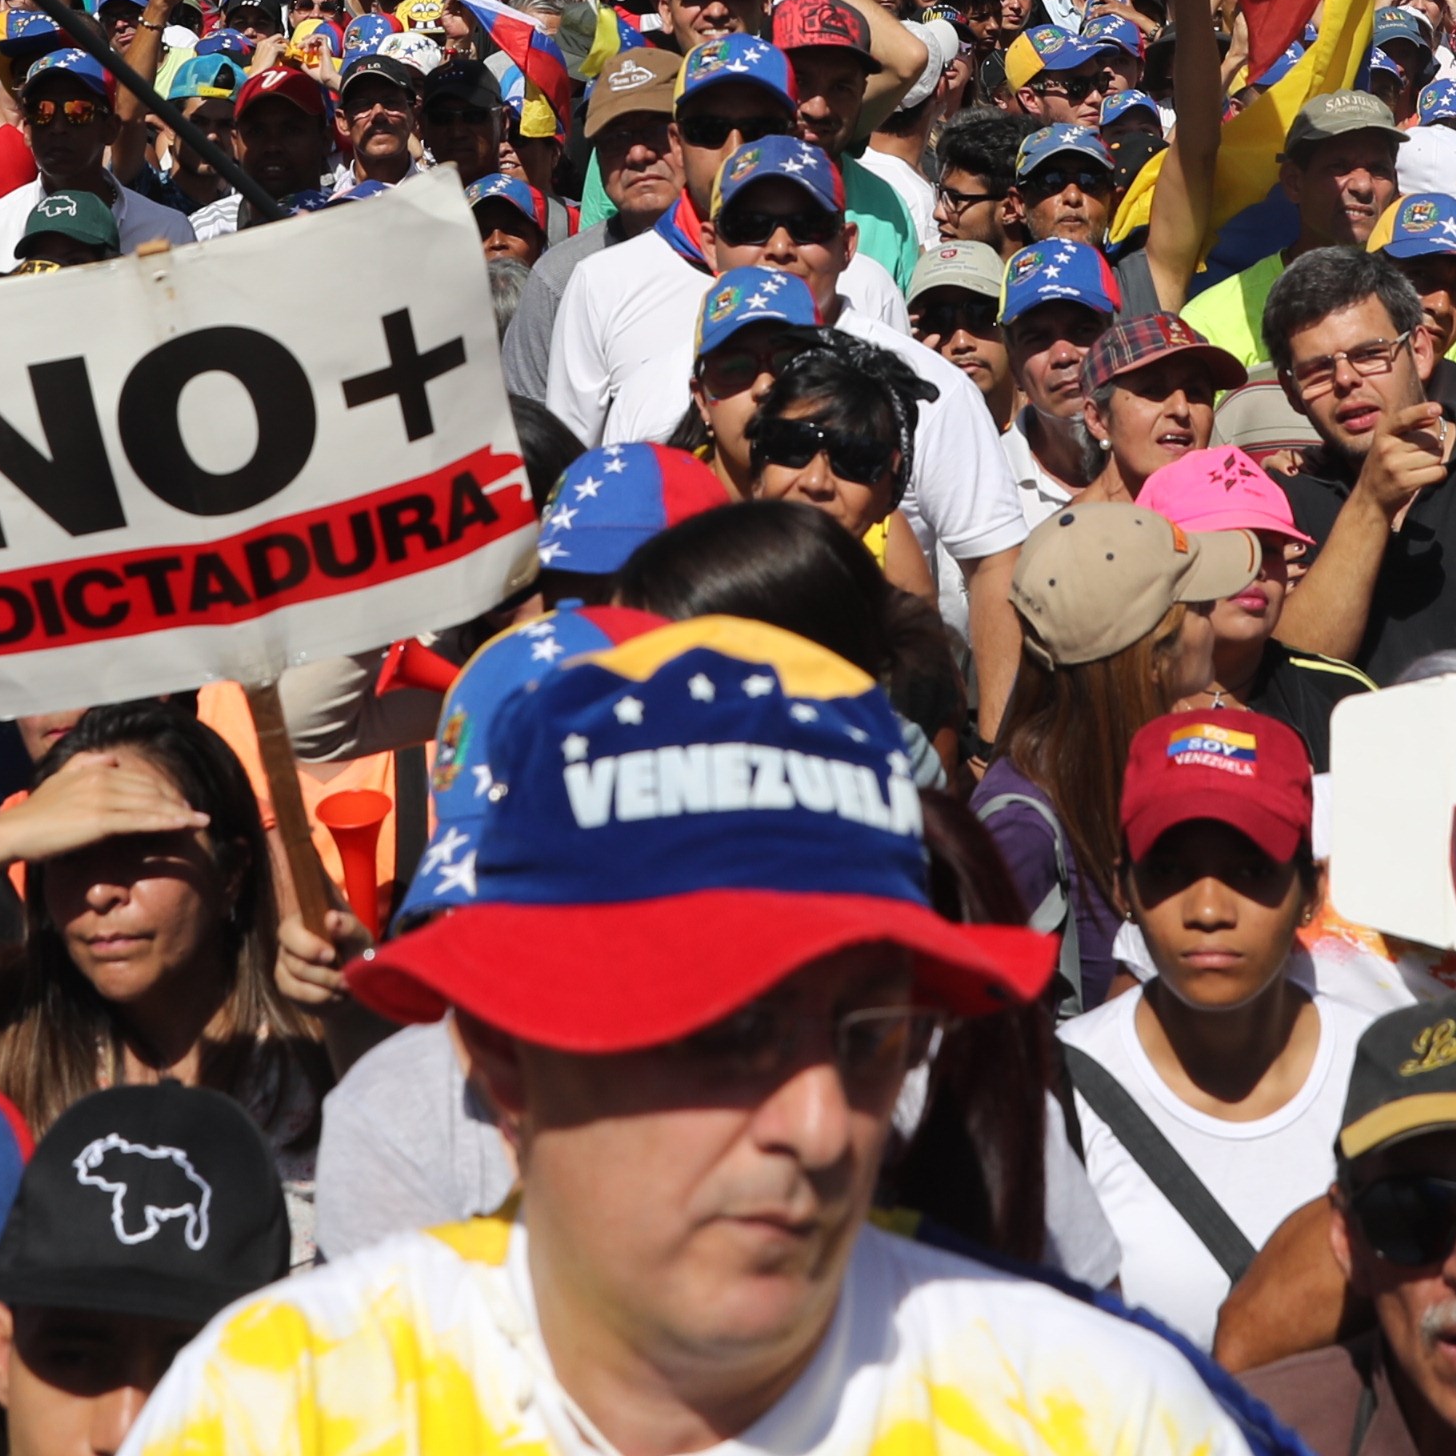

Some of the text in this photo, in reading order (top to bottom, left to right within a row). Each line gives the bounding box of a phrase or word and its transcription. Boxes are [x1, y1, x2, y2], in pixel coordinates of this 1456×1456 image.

[1325, 93, 1382, 114] SAN JUAN
[1204, 724, 1229, 740] YO
[1188, 737, 1238, 756] SOY
[1175, 751, 1255, 776] VENEZUELA
